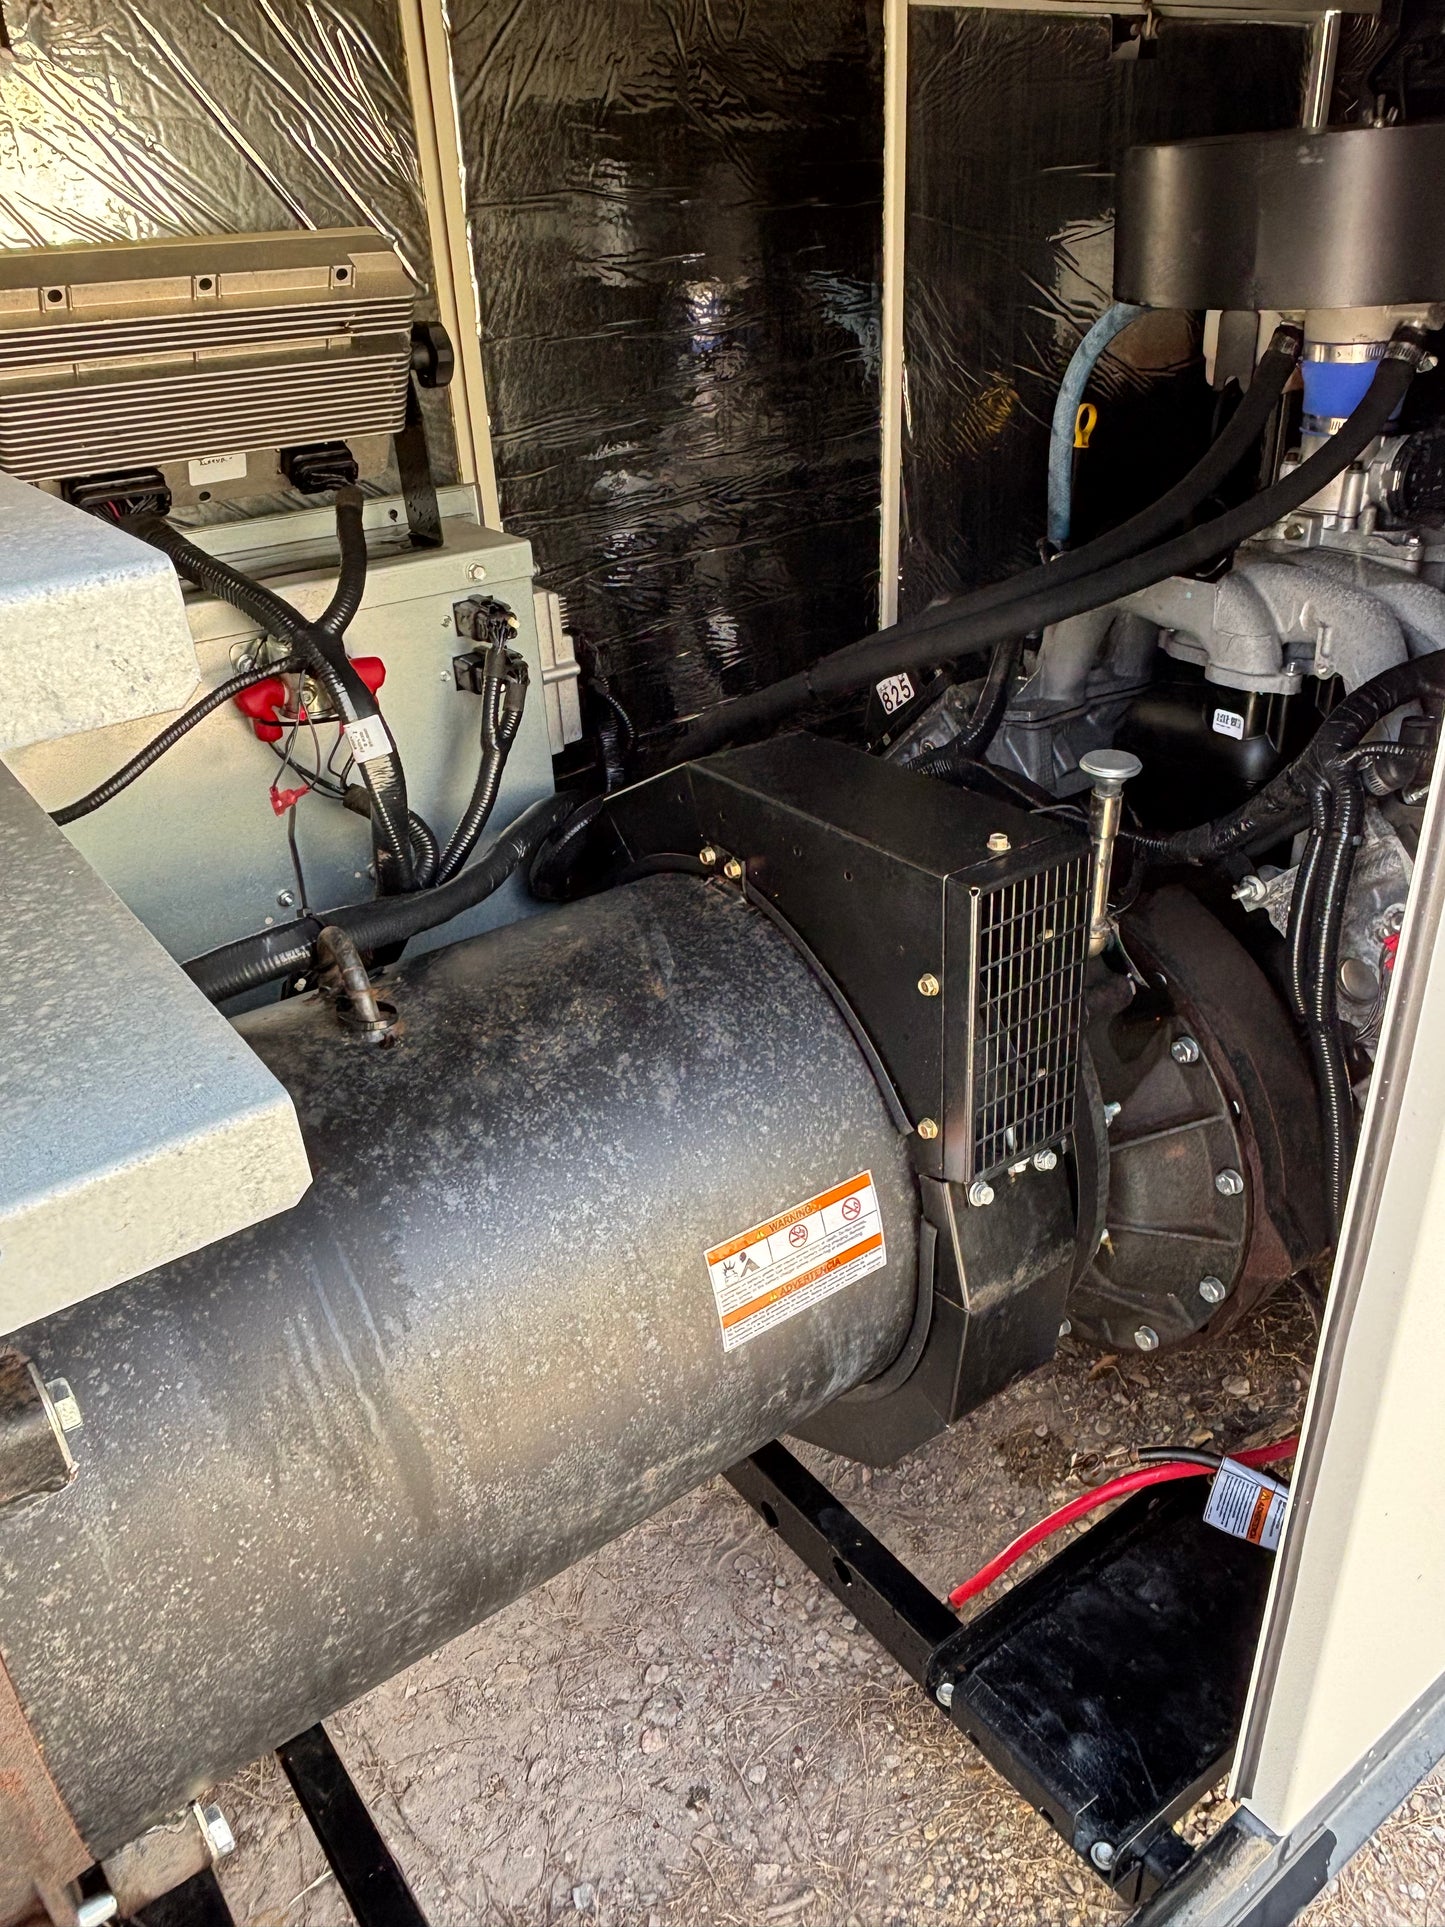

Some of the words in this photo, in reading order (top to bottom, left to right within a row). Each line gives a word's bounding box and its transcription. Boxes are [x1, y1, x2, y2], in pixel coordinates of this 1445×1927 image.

[882, 677, 911, 711] 825
[768, 1204, 813, 1233] WARNING
[779, 1259, 841, 1296] ADVERTENCIA
